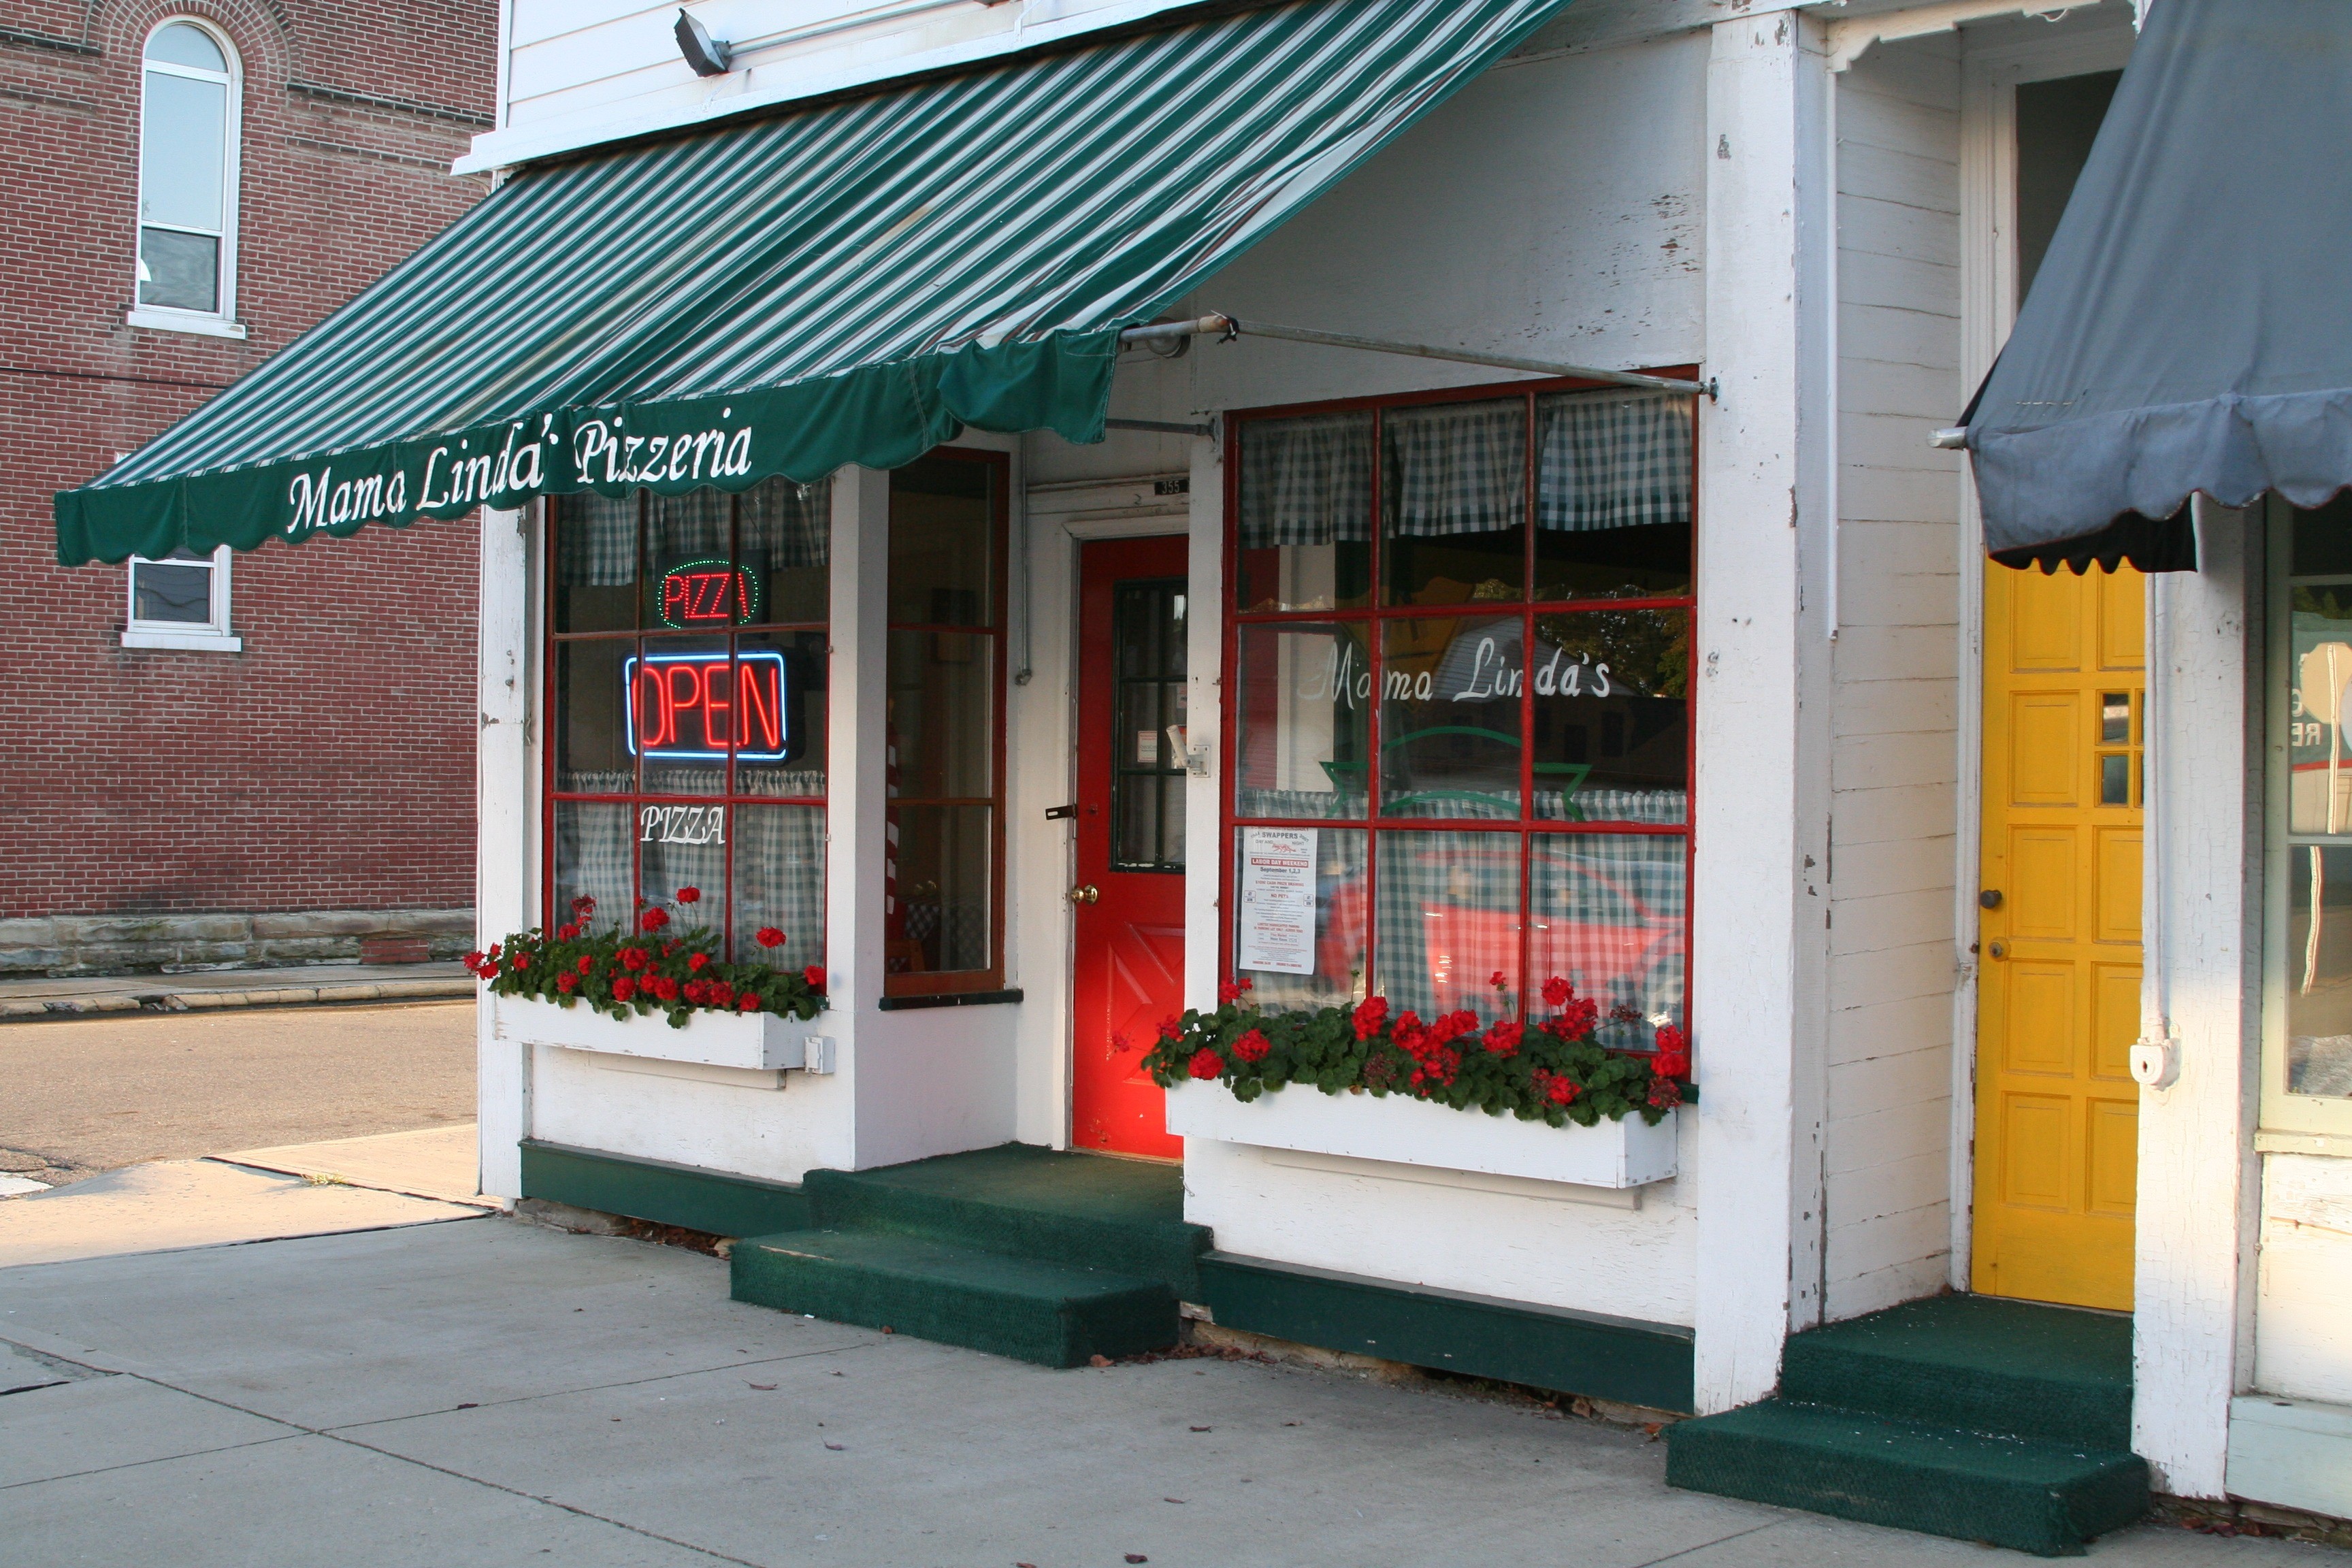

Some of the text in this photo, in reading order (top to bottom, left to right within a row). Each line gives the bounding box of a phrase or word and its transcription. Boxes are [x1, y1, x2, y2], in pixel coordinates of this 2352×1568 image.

[287, 466, 407, 534] Mama
[574, 408, 753, 485] Pizzeria
[1162, 480, 1180, 494] 355
[632, 662, 779, 747] OPEN
[1296, 637, 1611, 710] Mama Linda's
[639, 805, 726, 845] PIZZA
